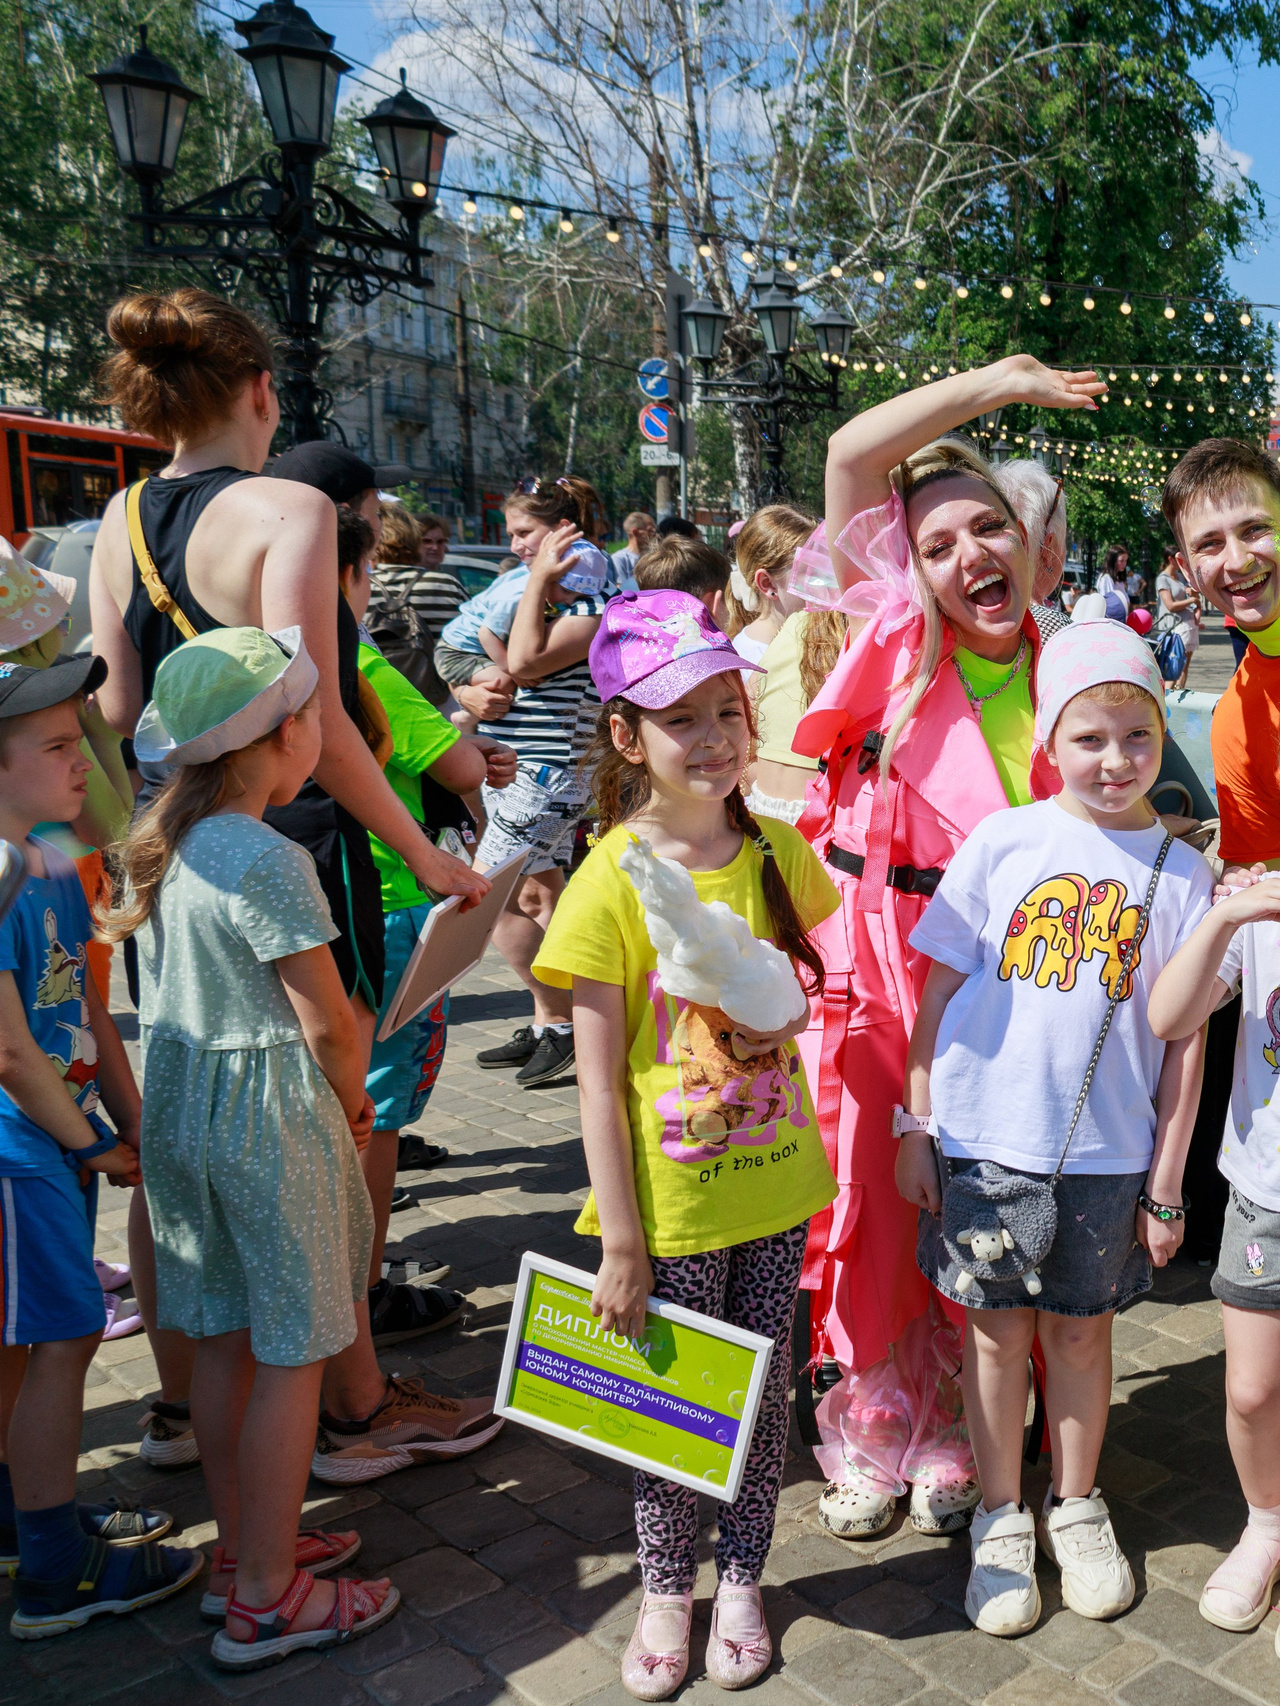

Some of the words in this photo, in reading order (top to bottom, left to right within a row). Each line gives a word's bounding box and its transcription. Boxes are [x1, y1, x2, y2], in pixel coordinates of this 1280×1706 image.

[699, 1161, 724, 1184] of
[733, 1154, 764, 1171] the
[771, 1139, 800, 1164] box
[1236, 1201, 1257, 1224] you?
[531, 1328, 542, 1336] ПО
[542, 1331, 603, 1358] ДЕКОРИРОВАНИЮ
[603, 1355, 642, 1373] ИМБИРНЫХ
[533, 1303, 651, 1358] ДИПЛОМ
[539, 1324, 591, 1349] ПРОХОЖДЕНИИ
[591, 1343, 646, 1367] МАСТЕР-КЛАССА
[525, 1358, 571, 1385] ЮНОМУ
[572, 1375, 642, 1409] КОНДИТЕРУ
[526, 1347, 569, 1371] ВЫДАН
[570, 1363, 621, 1390] САМОМУ
[622, 1382, 716, 1425] ТАЛАНТЛИВОМУ
